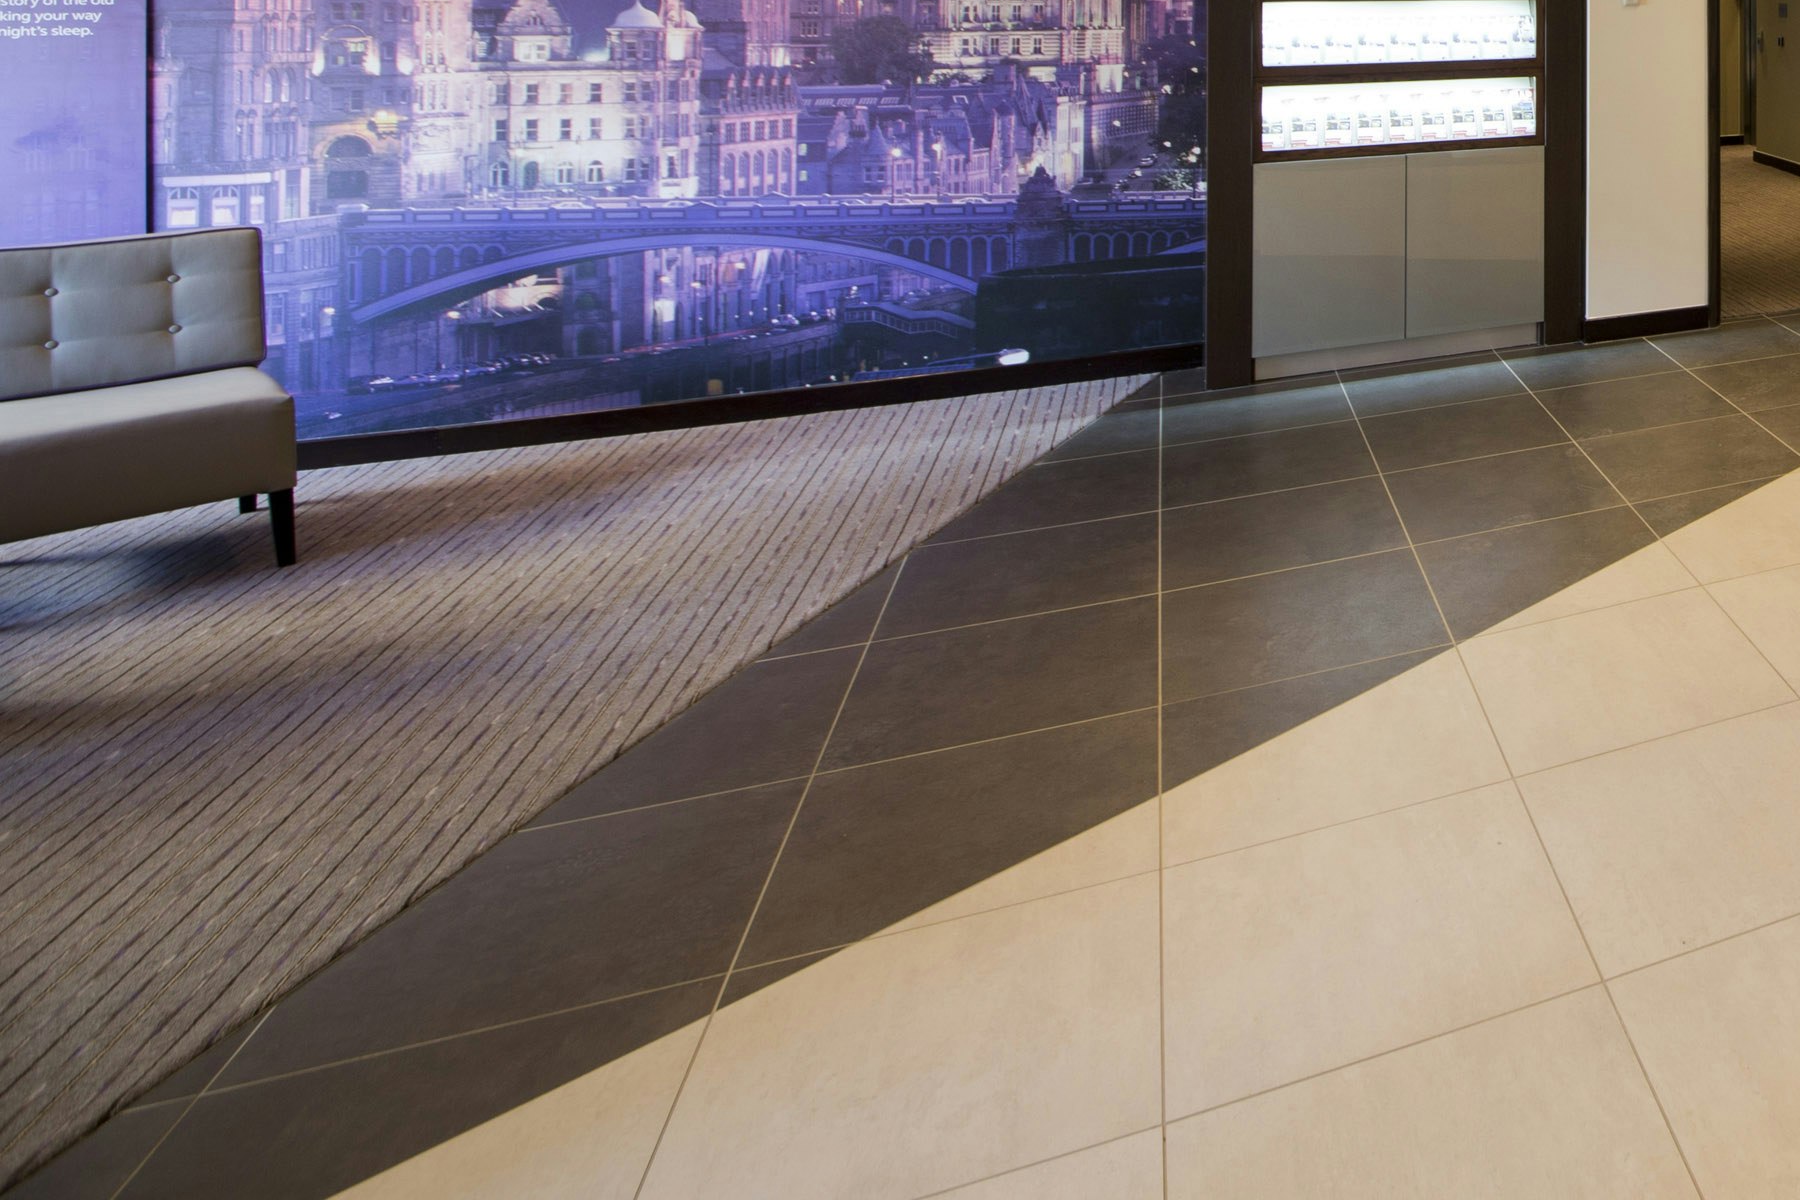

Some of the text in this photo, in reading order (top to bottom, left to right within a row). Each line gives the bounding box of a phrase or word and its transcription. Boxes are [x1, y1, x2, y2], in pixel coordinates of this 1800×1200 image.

[34, 12, 69, 24] your
[72, 12, 102, 23] way
[51, 25, 94, 38] sleep.
